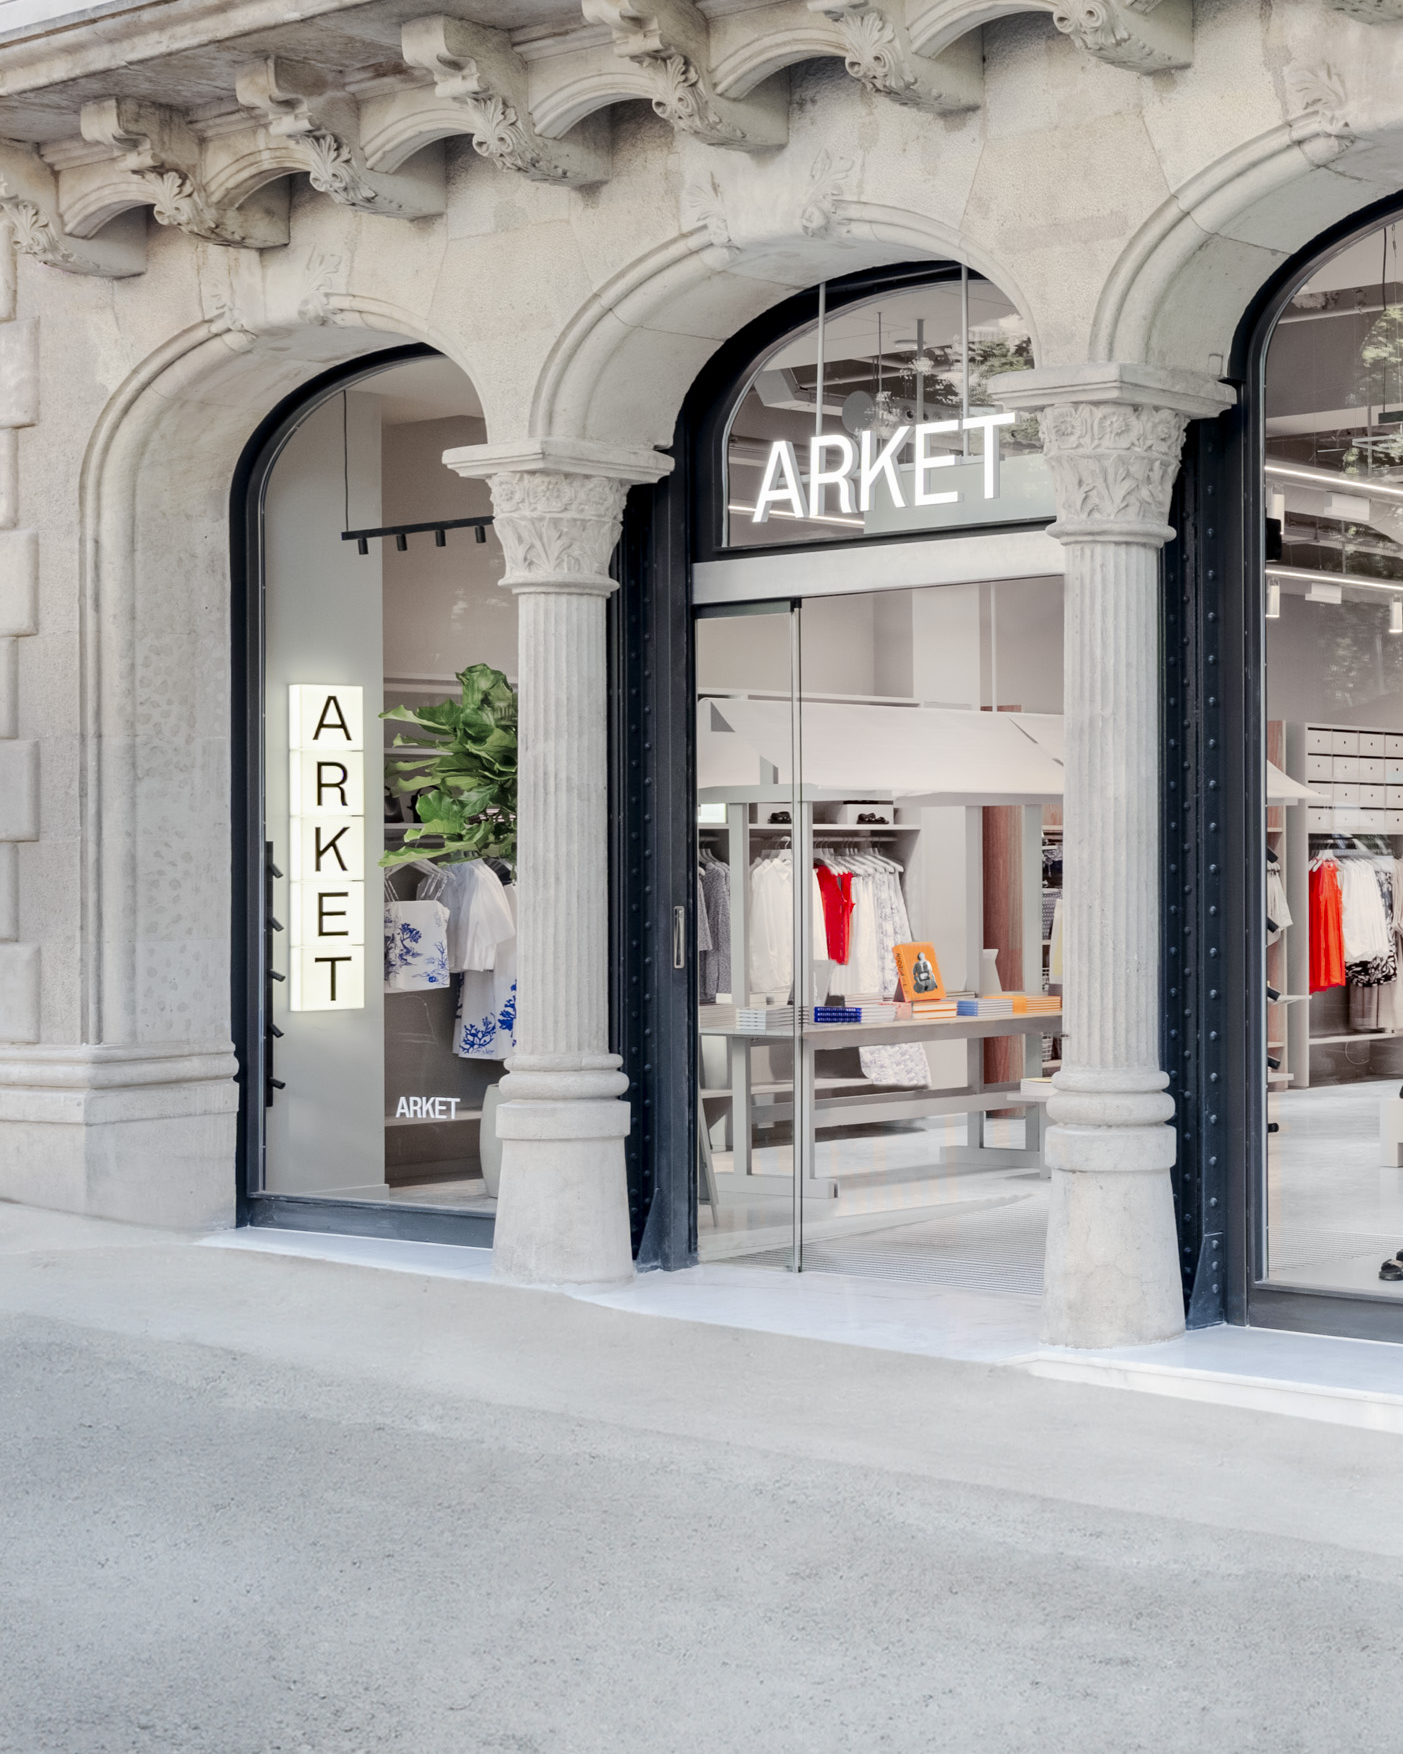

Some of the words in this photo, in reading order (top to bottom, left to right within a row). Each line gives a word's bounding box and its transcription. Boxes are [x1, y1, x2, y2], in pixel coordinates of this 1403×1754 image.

[752, 412, 1019, 523] ARKET
[312, 695, 353, 1002] ARKET
[395, 1096, 461, 1120] ARKET
